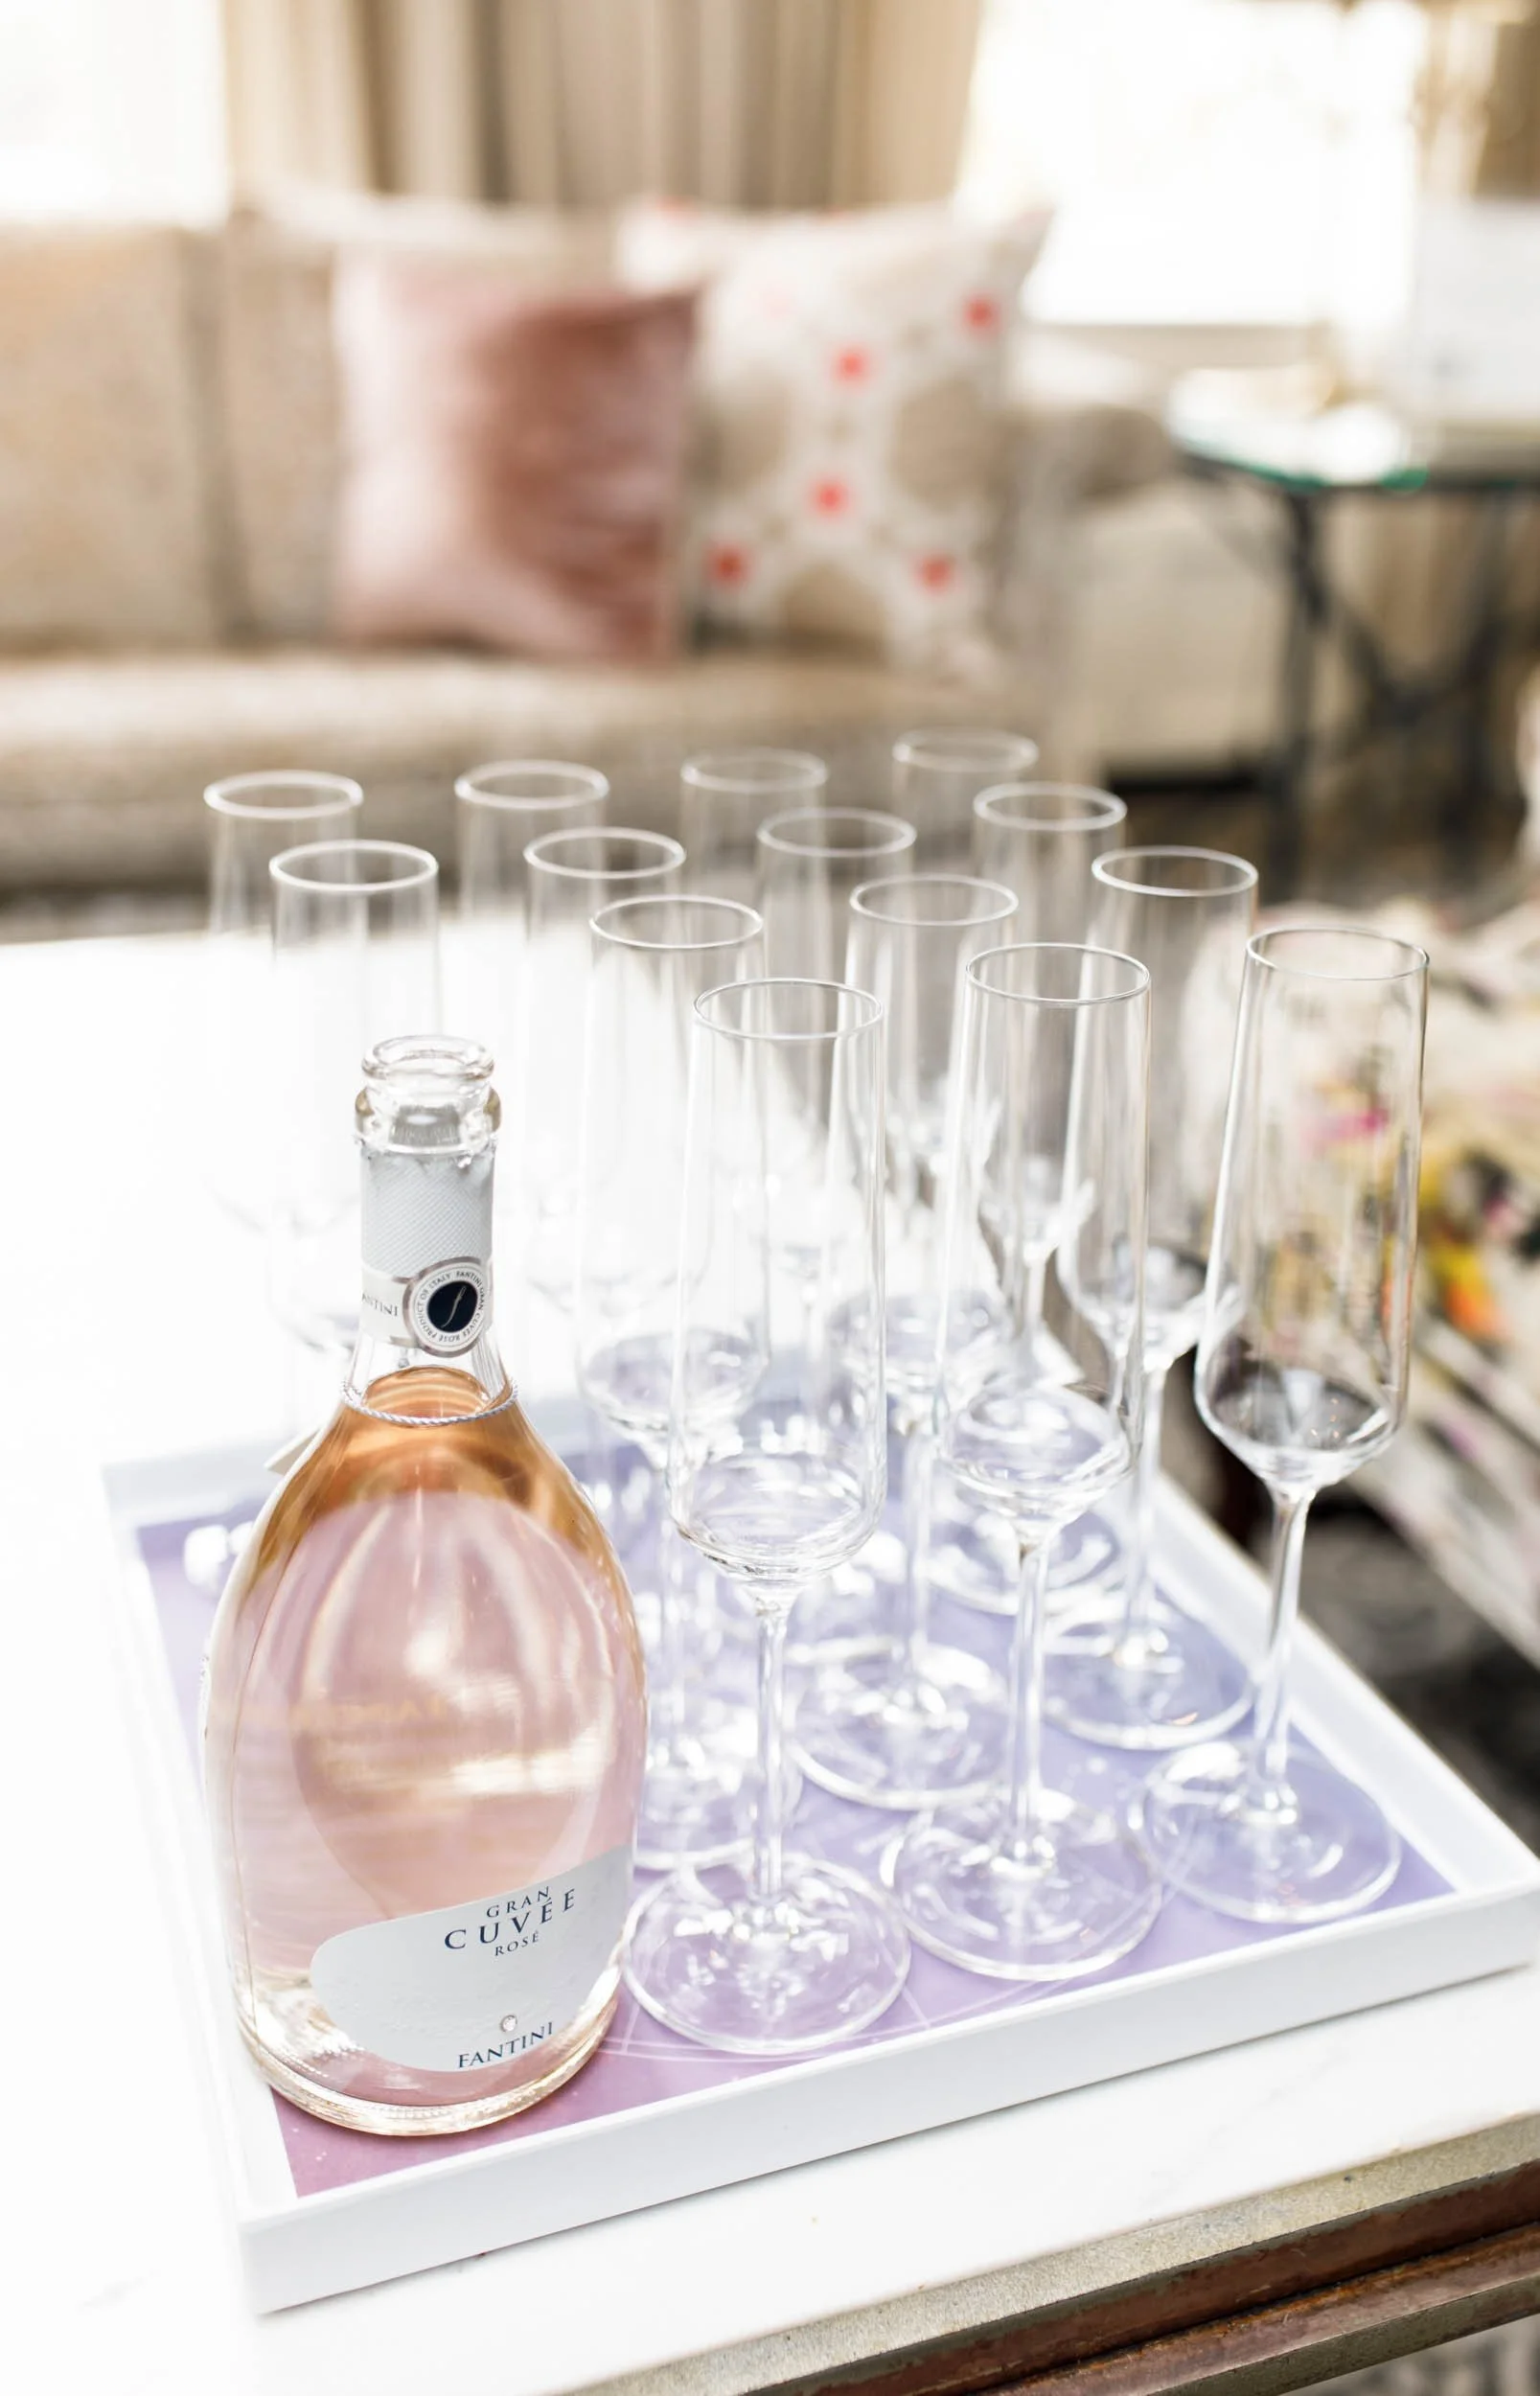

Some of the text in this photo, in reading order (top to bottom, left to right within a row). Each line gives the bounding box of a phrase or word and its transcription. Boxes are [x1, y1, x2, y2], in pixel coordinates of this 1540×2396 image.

[455, 1271, 482, 1288] FANTINI
[361, 1293, 398, 1317] ANTINI
[417, 1273, 451, 1338] PRODUCT OF ITALY
[486, 1885, 550, 1918] GRAN
[444, 1888, 575, 1950] CUVÉE
[494, 1929, 540, 1957] ROSÉ
[458, 2021, 553, 2068] FANTINI
